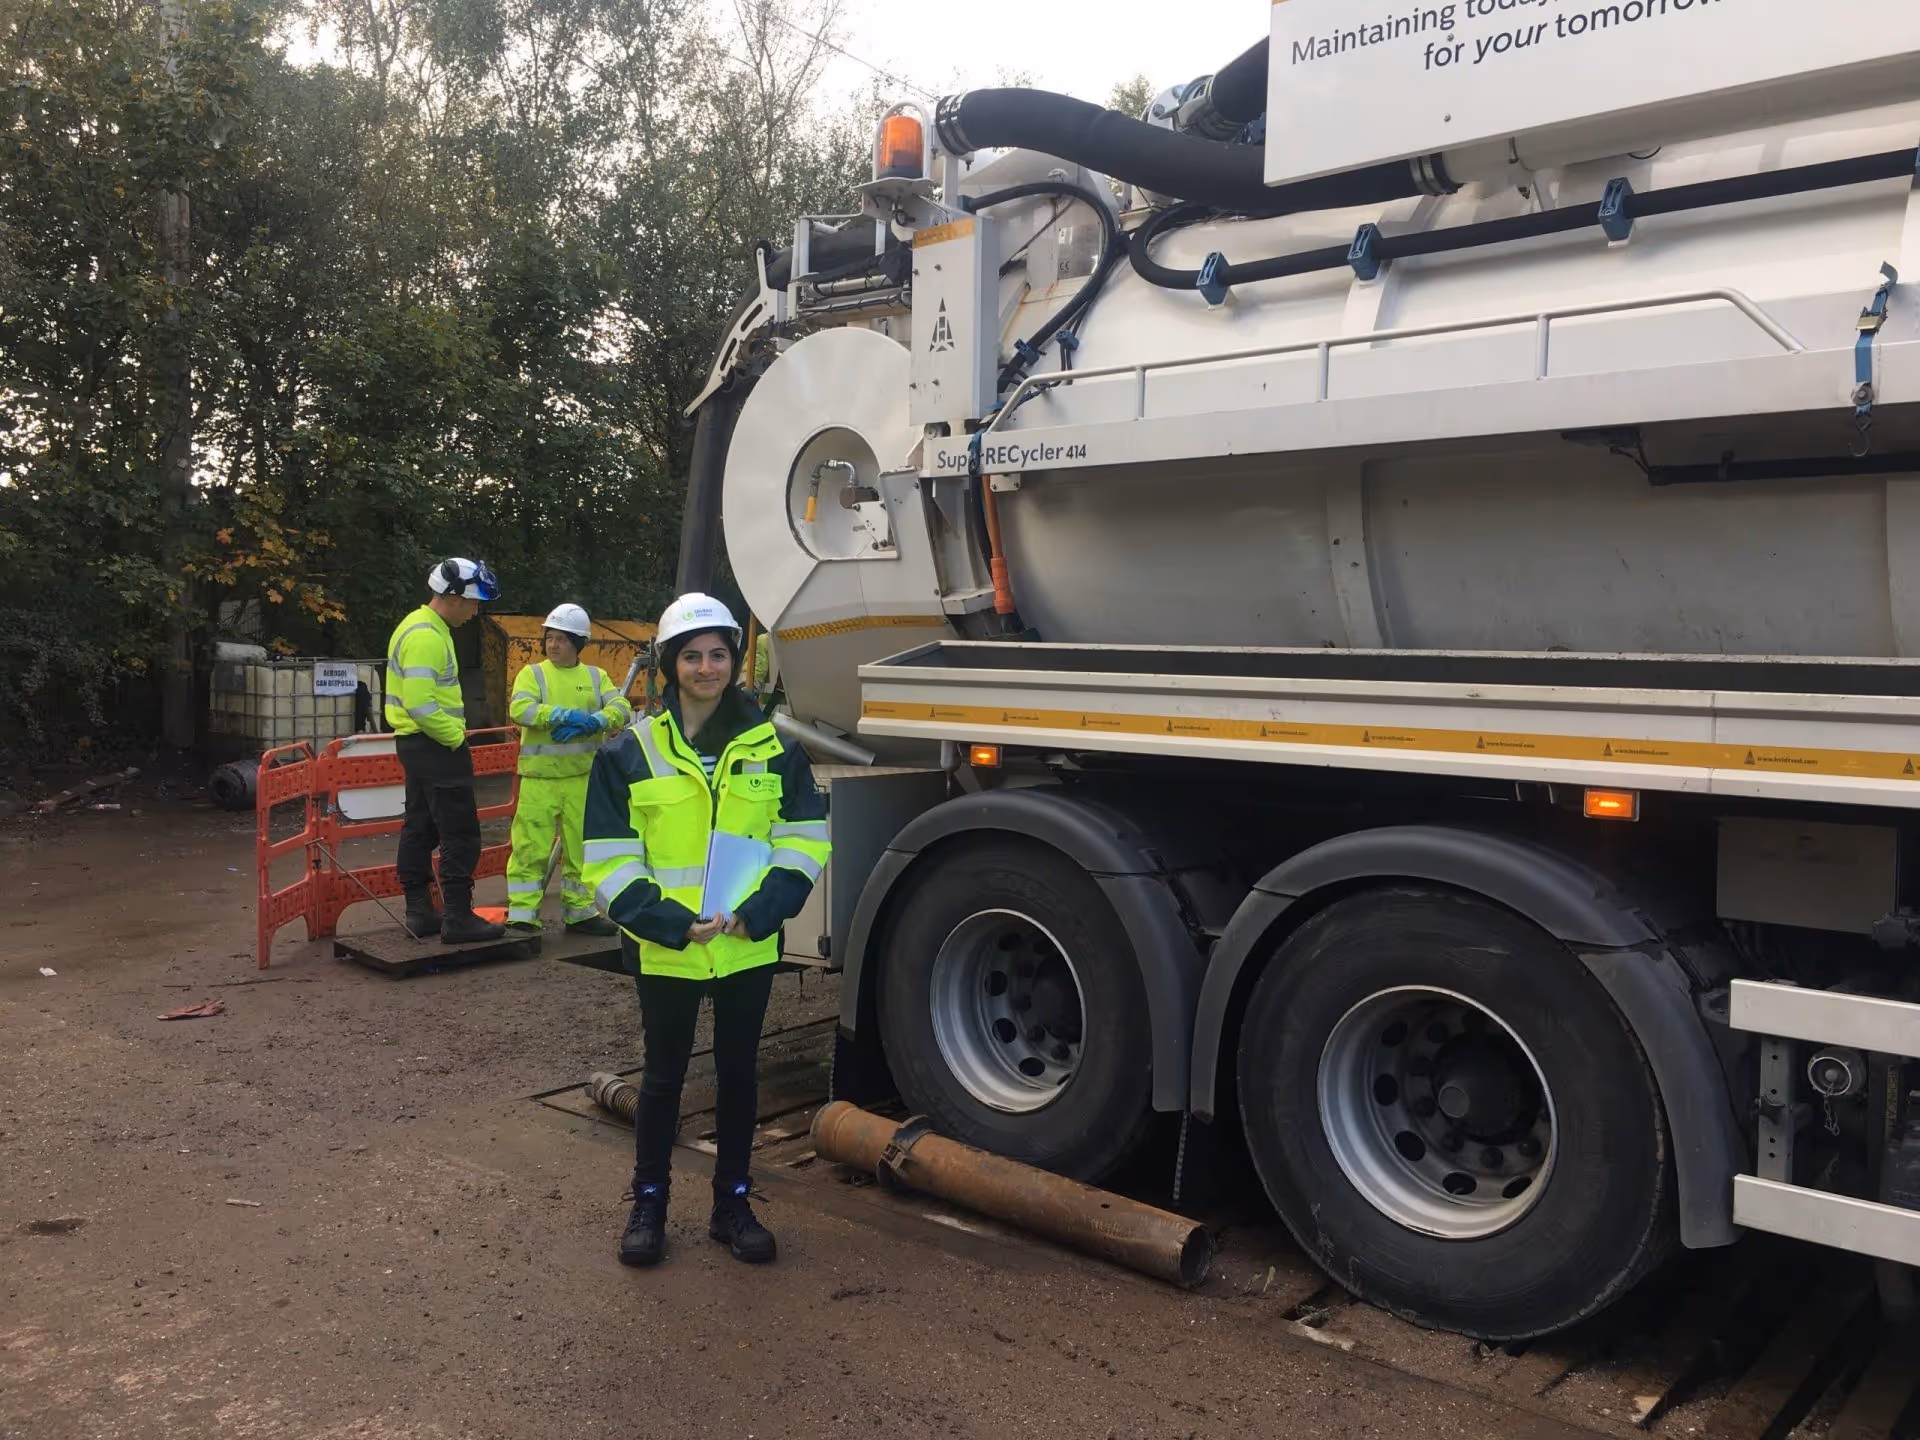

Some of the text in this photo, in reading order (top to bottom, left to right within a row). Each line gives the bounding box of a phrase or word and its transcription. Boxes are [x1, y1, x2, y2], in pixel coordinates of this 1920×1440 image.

[1291, 3, 1457, 65] Maintaining
[1423, 42, 1465, 70] for
[1473, 22, 1548, 65] your
[1555, 0, 1721, 38] tomorr
[937, 442, 1087, 472] SupRECycler 414
